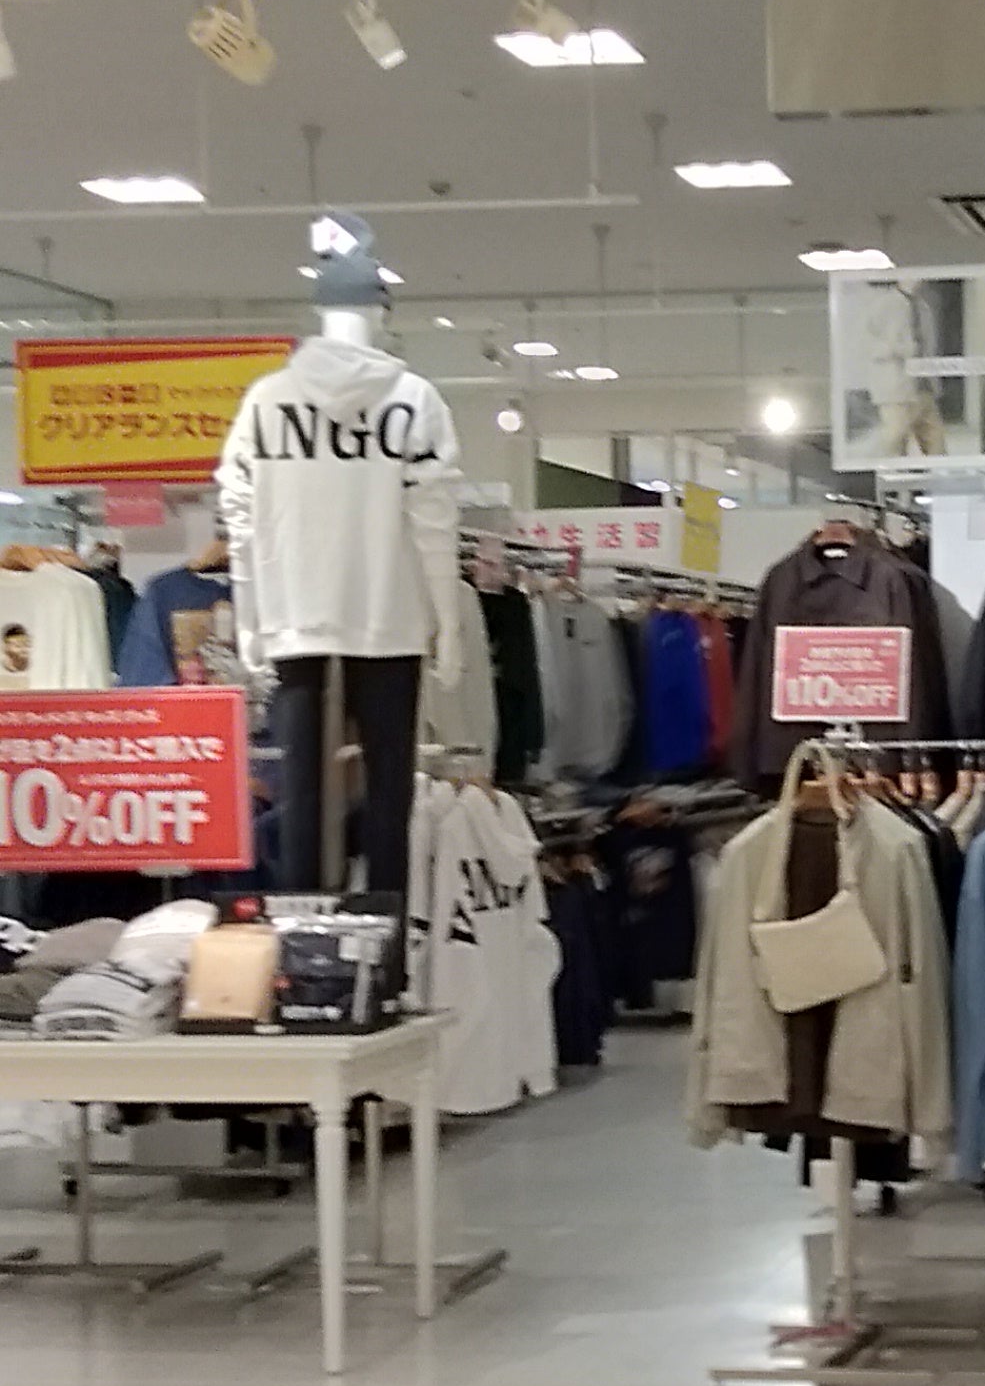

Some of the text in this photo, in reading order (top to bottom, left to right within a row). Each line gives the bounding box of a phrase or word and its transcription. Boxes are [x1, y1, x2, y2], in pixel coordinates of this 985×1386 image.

[38, 411, 232, 441] クリアランスセ
